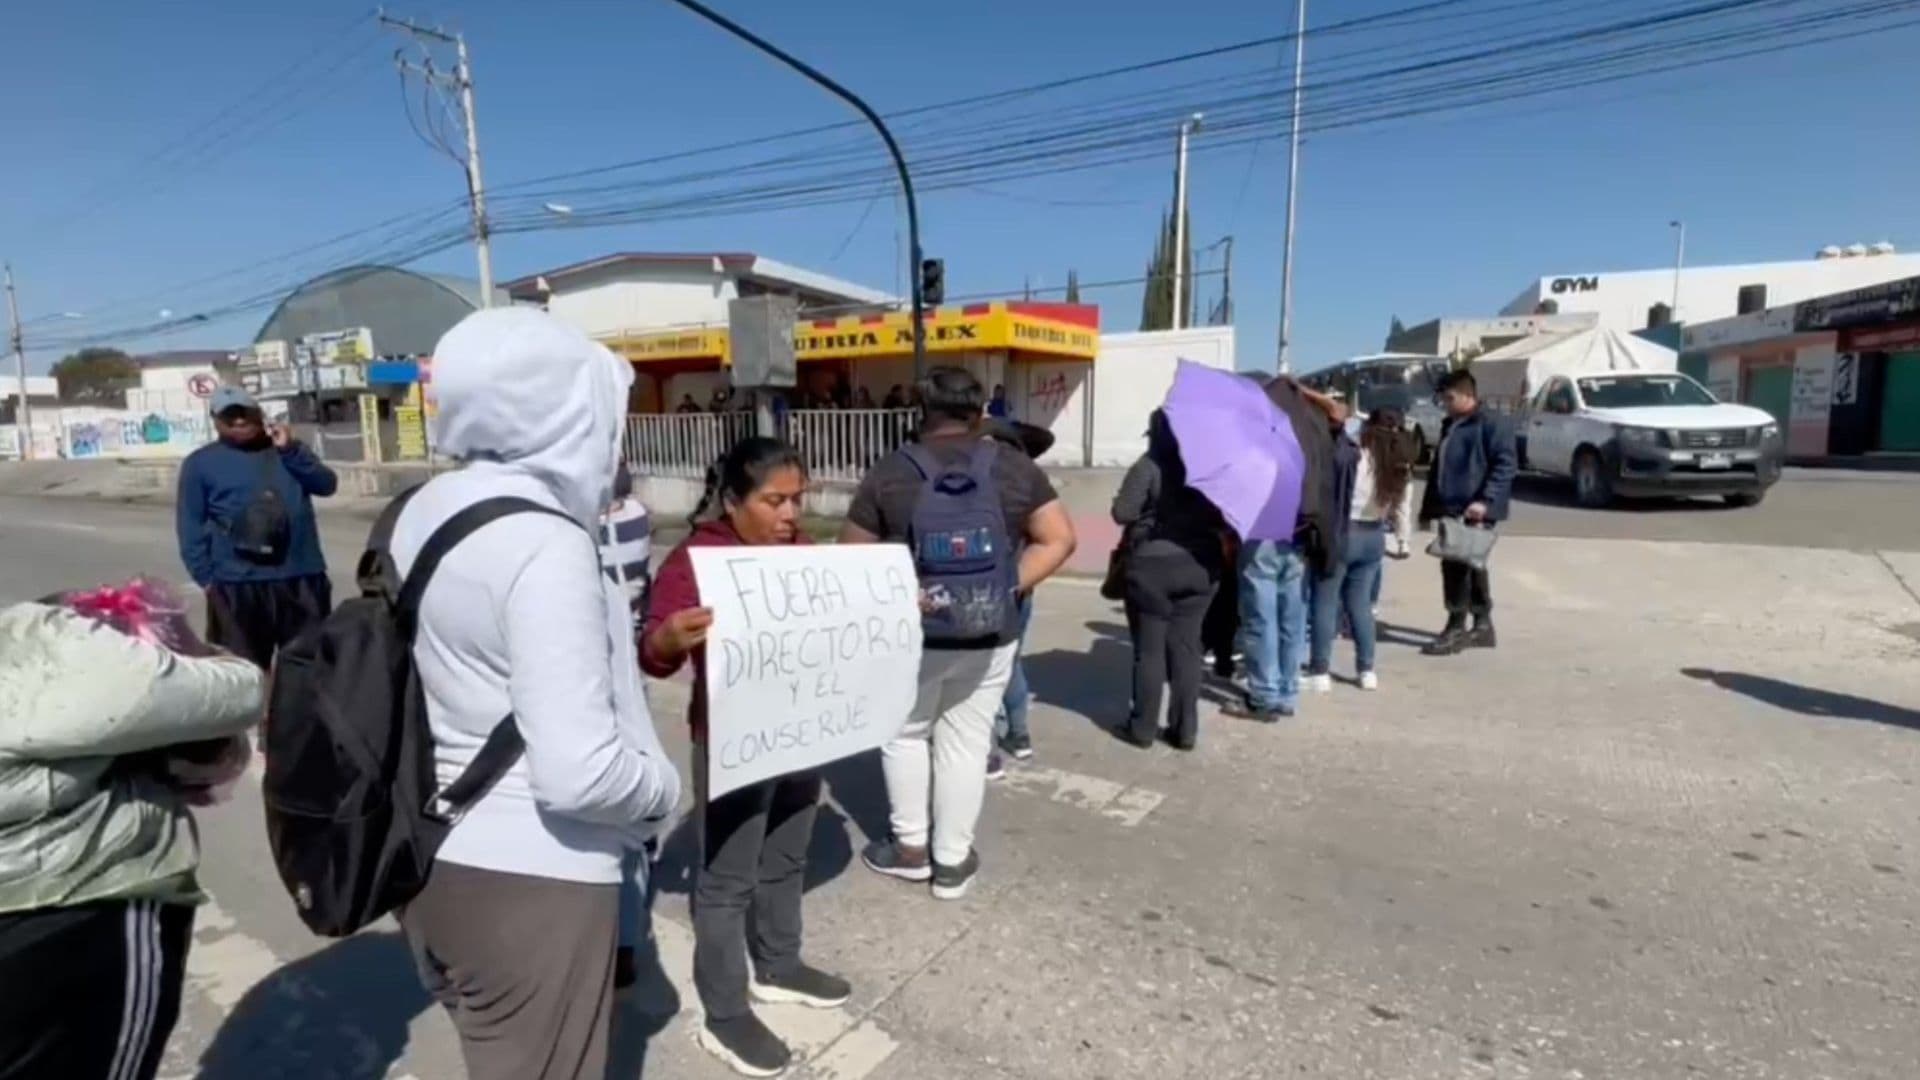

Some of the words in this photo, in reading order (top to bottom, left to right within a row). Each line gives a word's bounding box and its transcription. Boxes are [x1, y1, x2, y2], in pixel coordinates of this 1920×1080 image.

[1551, 276, 1599, 293] GYM
[794, 331, 879, 351] UERIA
[894, 324, 978, 344] AEX
[726, 557, 847, 629] FUERA
[864, 565, 910, 605] LA
[721, 615, 914, 688] DIRECTORA
[789, 680, 801, 707] Y
[814, 671, 845, 698] EL
